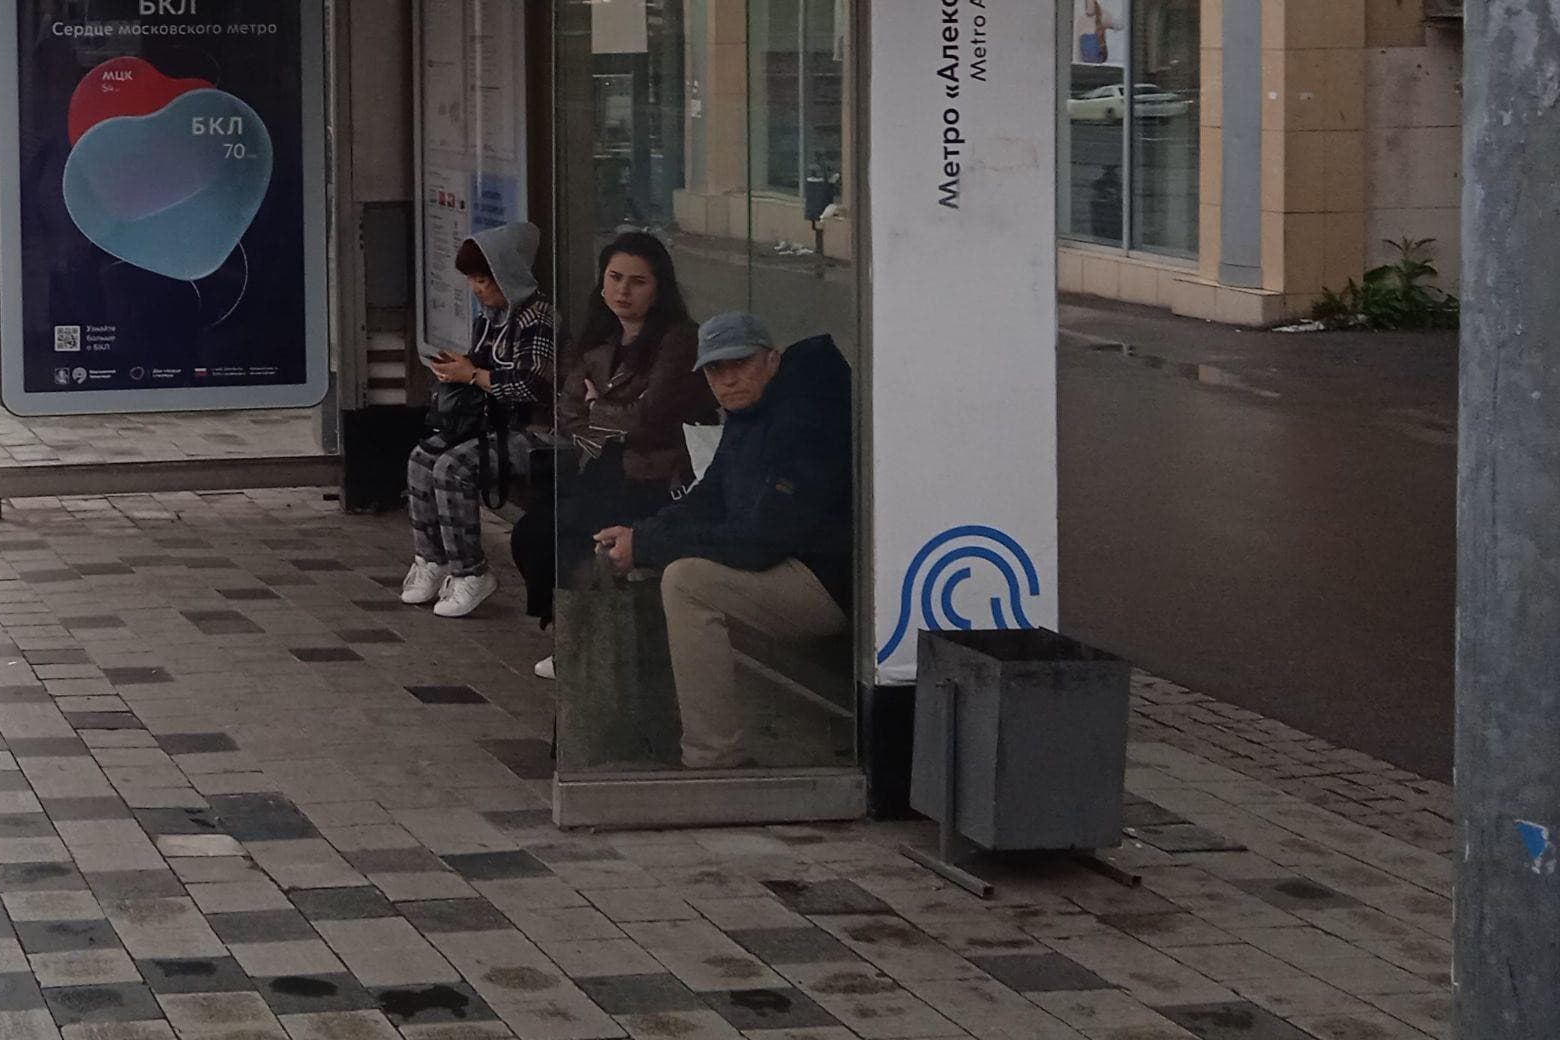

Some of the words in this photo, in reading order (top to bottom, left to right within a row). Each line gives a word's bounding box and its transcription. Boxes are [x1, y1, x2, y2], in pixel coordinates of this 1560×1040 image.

[51, 21, 113, 38] Сердце
[118, 22, 222, 35] московского
[226, 21, 278, 35] метро
[969, 15, 987, 82] Metro
[102, 71, 133, 82] МЦК
[191, 116, 243, 135] БКЛ
[223, 143, 246, 159] 70
[938, 107, 966, 209] Метро
